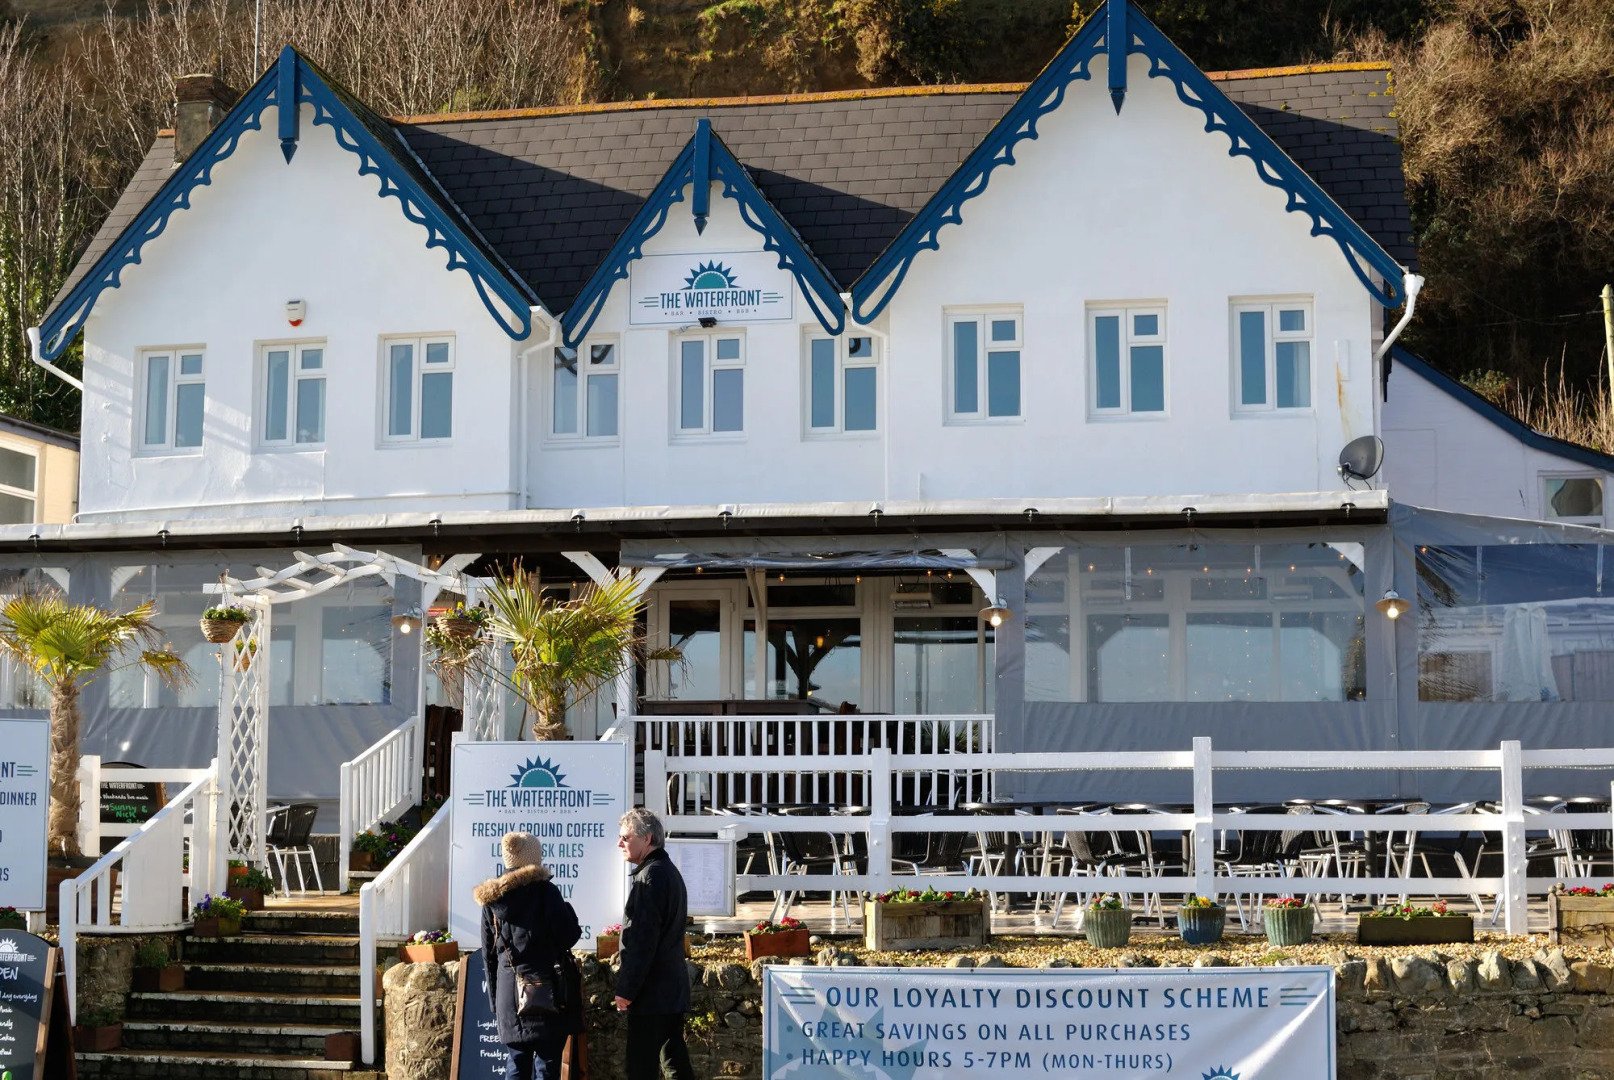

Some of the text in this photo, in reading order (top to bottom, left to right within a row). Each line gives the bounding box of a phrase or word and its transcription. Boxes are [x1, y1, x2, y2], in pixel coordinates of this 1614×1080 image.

[660, 289, 761, 309] THE WATERFRONT
[109, 782, 138, 790] WATERFRONT
[485, 789, 592, 807] THE WATERFRONT
[472, 822, 605, 838] FRESHLY GROUND COFFEE
[558, 843, 584, 858] ALES
[826, 986, 1269, 1009] OUR LOYALTY DISCOUNT SCHEME
[802, 1021, 1191, 1042] GREAT SAVINGS ON ALL PURCHASES
[802, 1048, 1174, 1073] HAPPY HOURS 5-7PM (MON-THURS)
